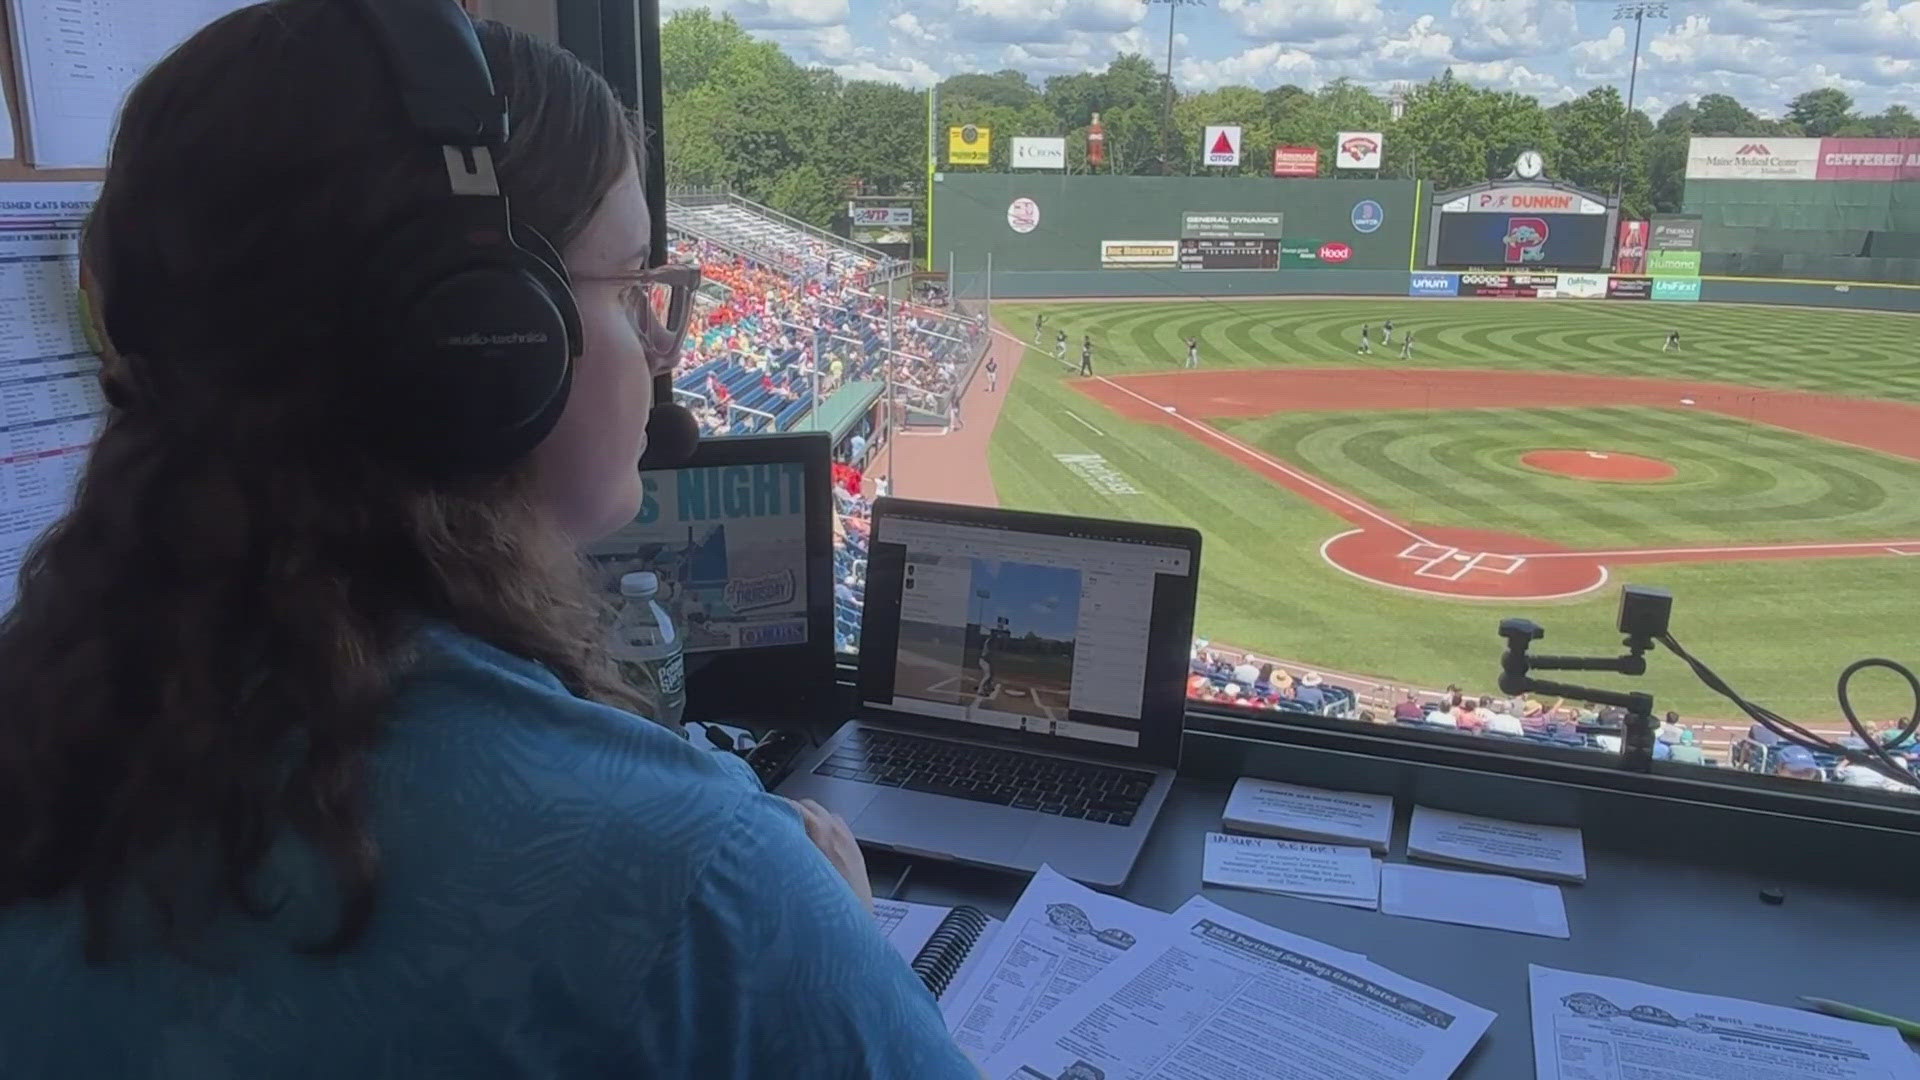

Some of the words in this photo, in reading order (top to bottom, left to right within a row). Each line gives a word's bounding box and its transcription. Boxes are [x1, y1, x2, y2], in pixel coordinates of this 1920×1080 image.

[1706, 156, 1732, 166] Maine
[1735, 157, 1768, 166] Medical
[1770, 157, 1799, 166] Center
[1825, 154, 1903, 166] CENTERED
[34, 201, 59, 209] CATS
[1511, 196, 1573, 208] DUNKIN'
[1186, 216, 1229, 224] GENERAL
[1230, 216, 1280, 224] DYNAMICS
[1320, 246, 1349, 258] Hood
[1413, 278, 1448, 289] unum
[1656, 281, 1696, 292] UniFirst
[448, 332, 548, 345] audio-technica
[677, 463, 804, 522] NIGHT
[1235, 936, 1283, 958] Portland
[1281, 953, 1303, 965] Sea
[1305, 960, 1332, 977] Dogs
[1332, 972, 1364, 988] Game
[1366, 984, 1398, 1004] Notes
